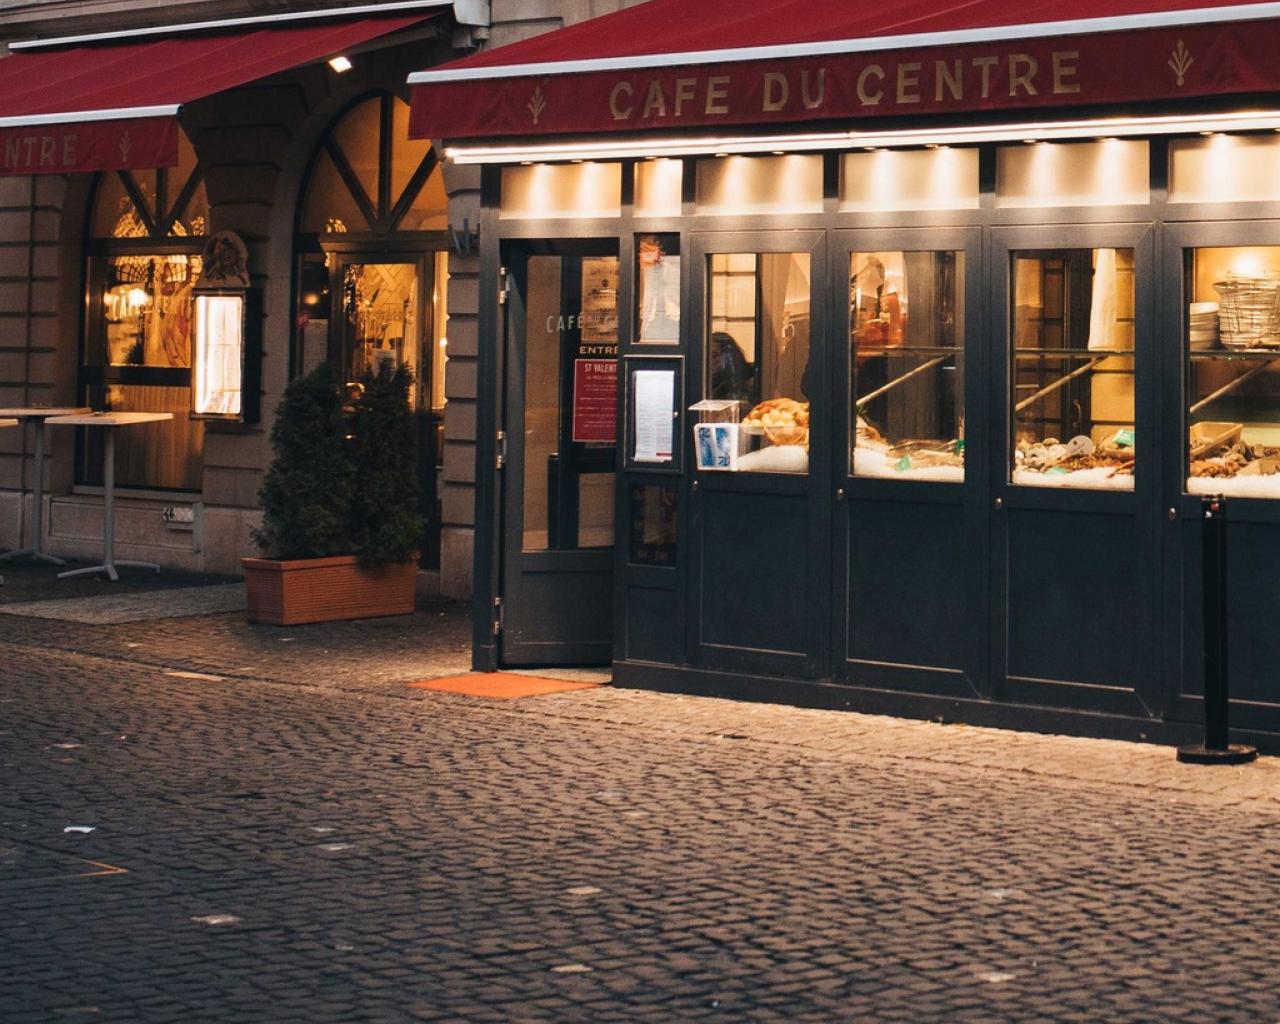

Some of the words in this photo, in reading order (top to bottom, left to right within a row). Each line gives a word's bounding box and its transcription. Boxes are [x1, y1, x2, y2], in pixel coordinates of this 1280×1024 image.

[609, 77, 731, 120] CAFE
[763, 68, 827, 112] DU
[856, 50, 1081, 106] CENTRE
[6, 135, 76, 168] NTRE
